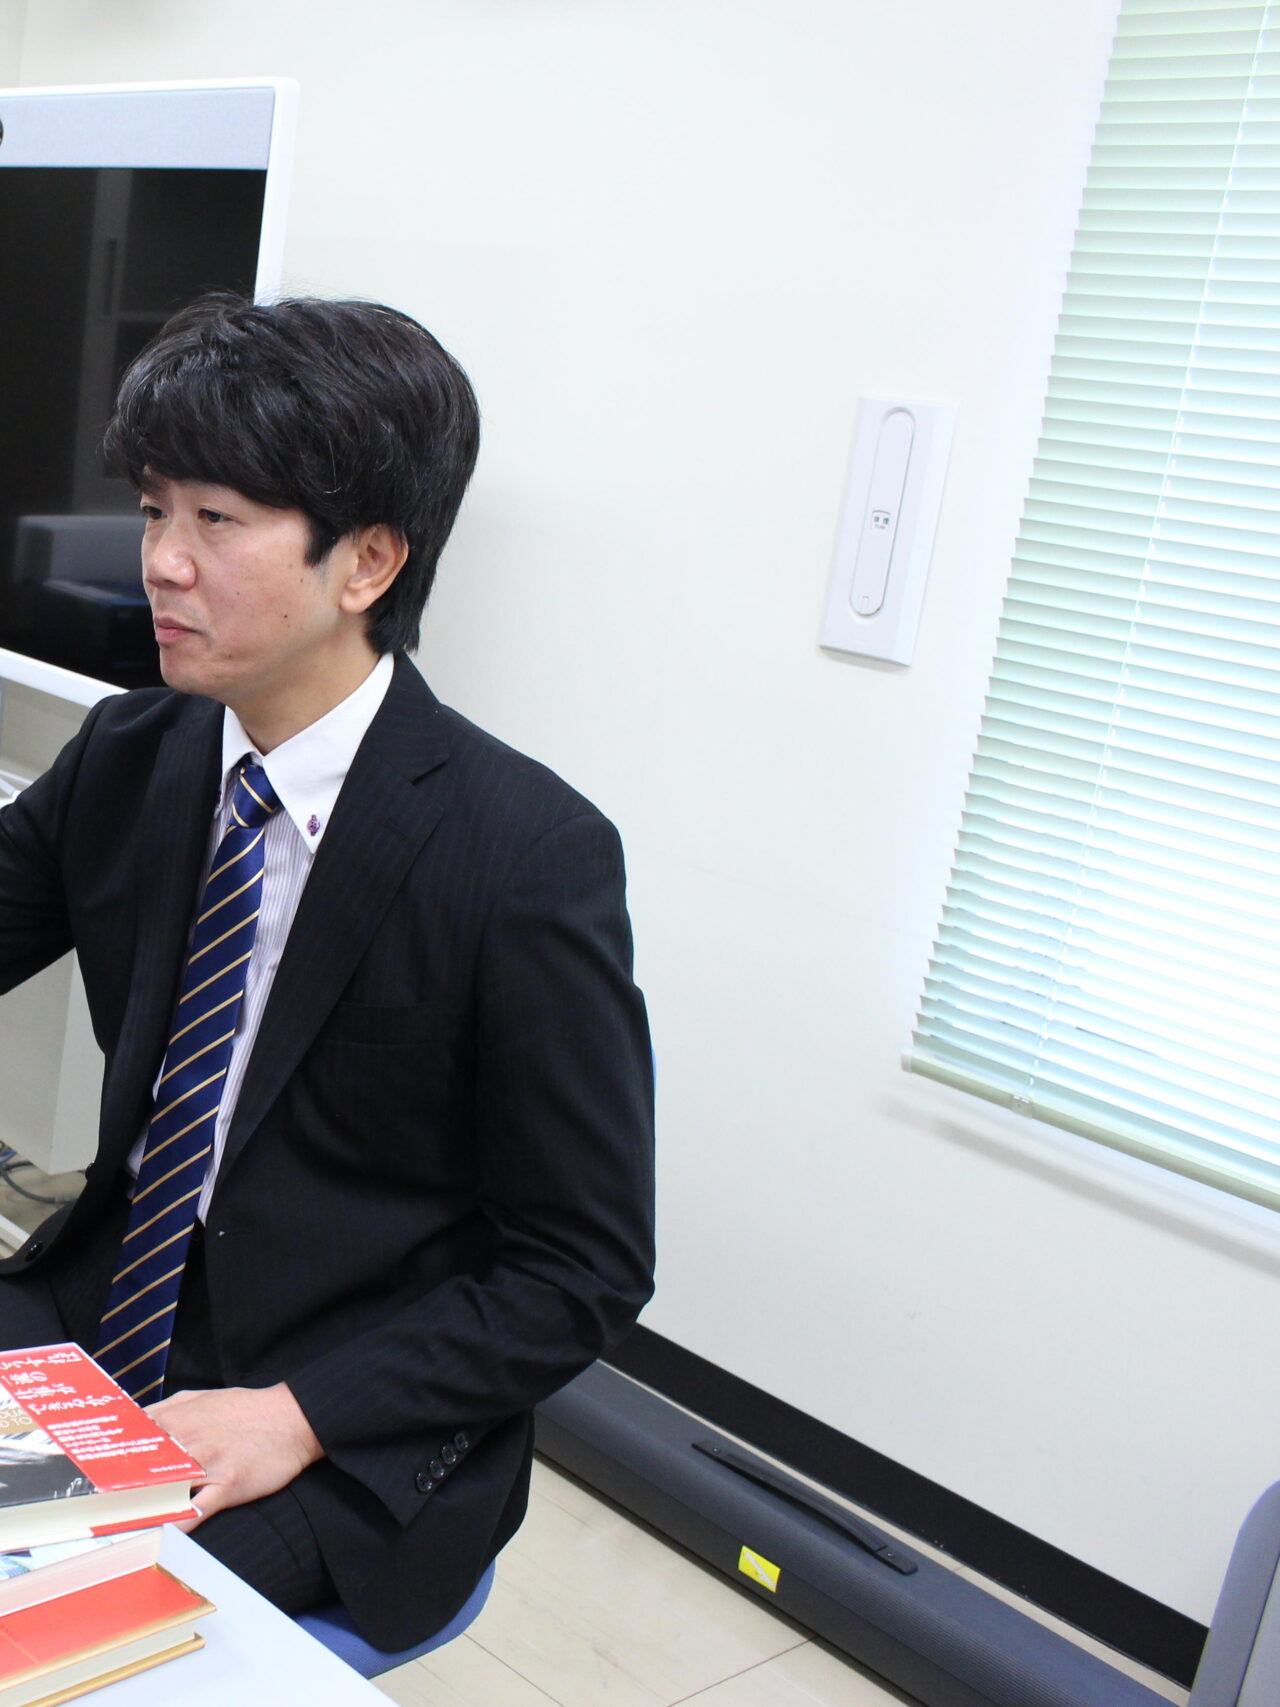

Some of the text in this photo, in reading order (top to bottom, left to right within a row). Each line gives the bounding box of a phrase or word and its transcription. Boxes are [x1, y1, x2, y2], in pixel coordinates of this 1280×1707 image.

[9, 1381, 79, 1400] 仕事が
[9, 1416, 35, 1426] TO
